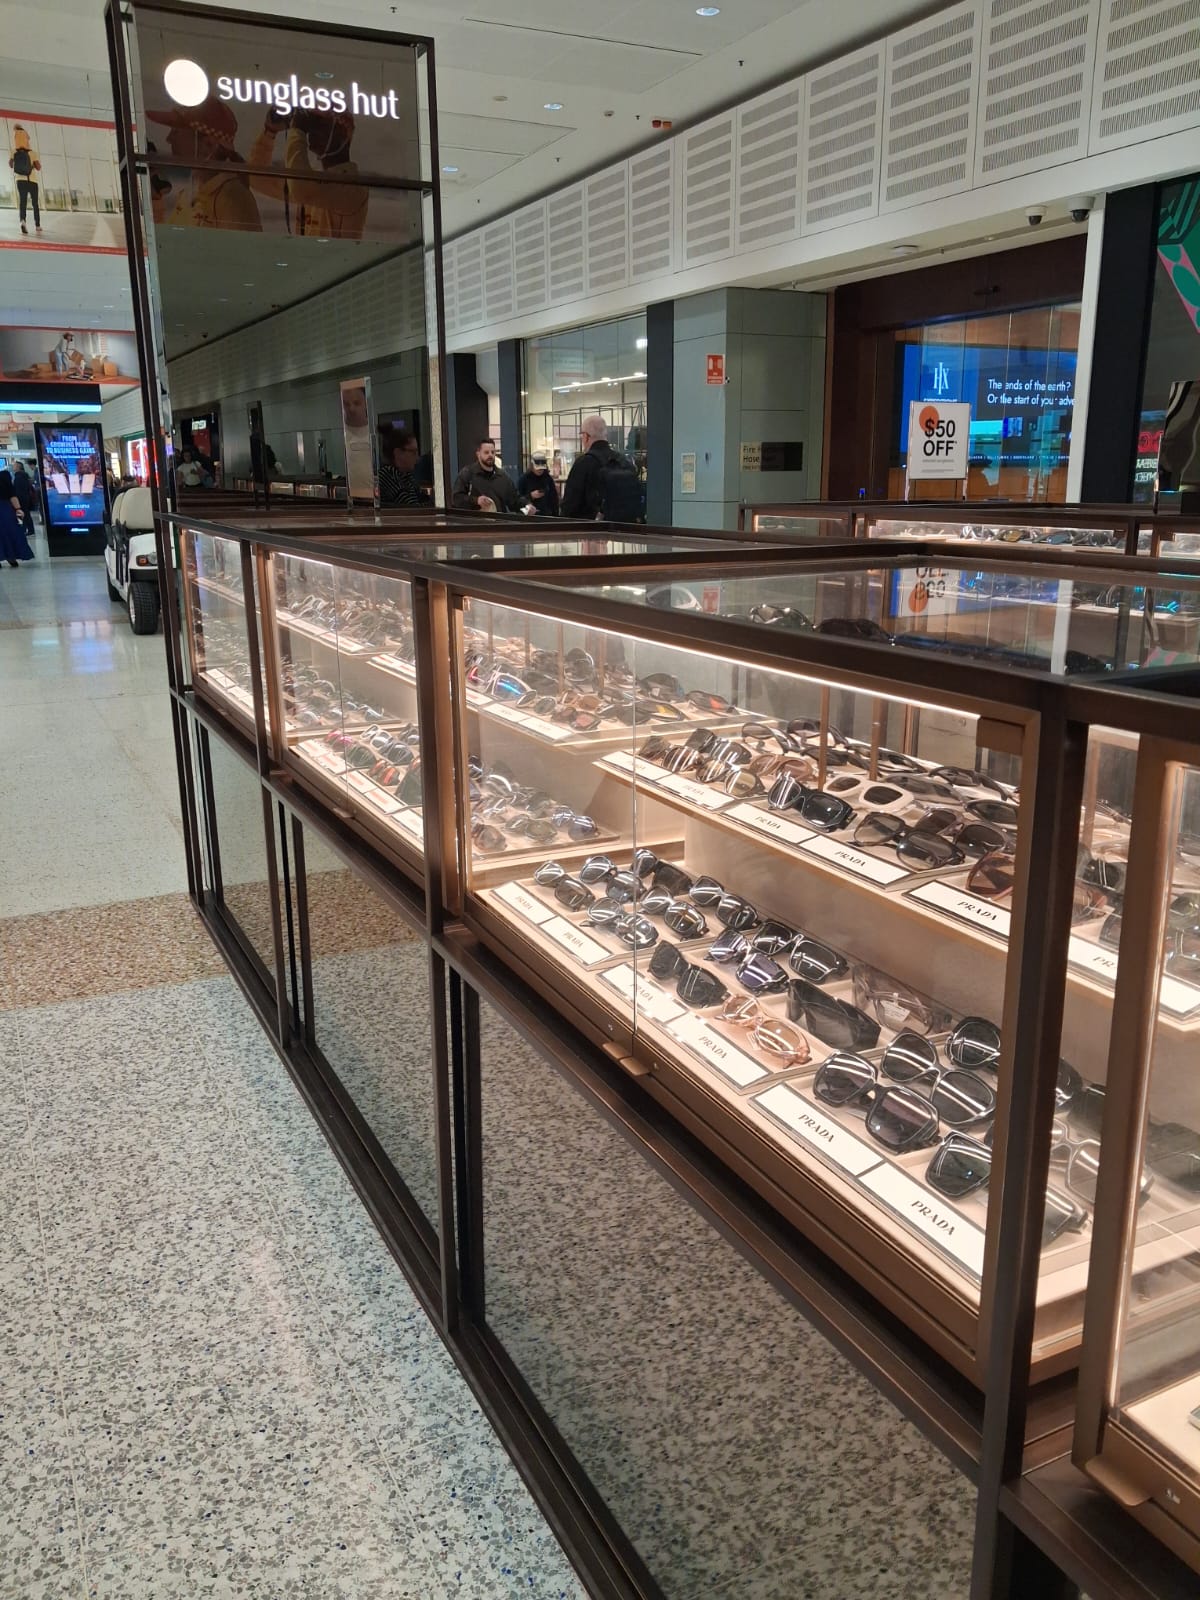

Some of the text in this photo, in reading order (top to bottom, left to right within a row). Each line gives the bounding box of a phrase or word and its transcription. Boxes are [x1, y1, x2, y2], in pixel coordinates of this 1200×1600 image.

[217, 75, 400, 119] sunglass hut
[988, 379, 1072, 392] The ends of the earth?
[987, 393, 998, 404] Or
[1000, 393, 1012, 404] the
[1013, 394, 1030, 405] start
[1031, 393, 1040, 405] of
[924, 417, 956, 439] $50
[757, 815, 782, 830] PRADA
[834, 850, 866, 867] PRADA
[957, 900, 998, 922] PRADA
[698, 1035, 728, 1060] PRADA
[798, 1113, 835, 1143] PRADA
[910, 1200, 956, 1236] PRADA
